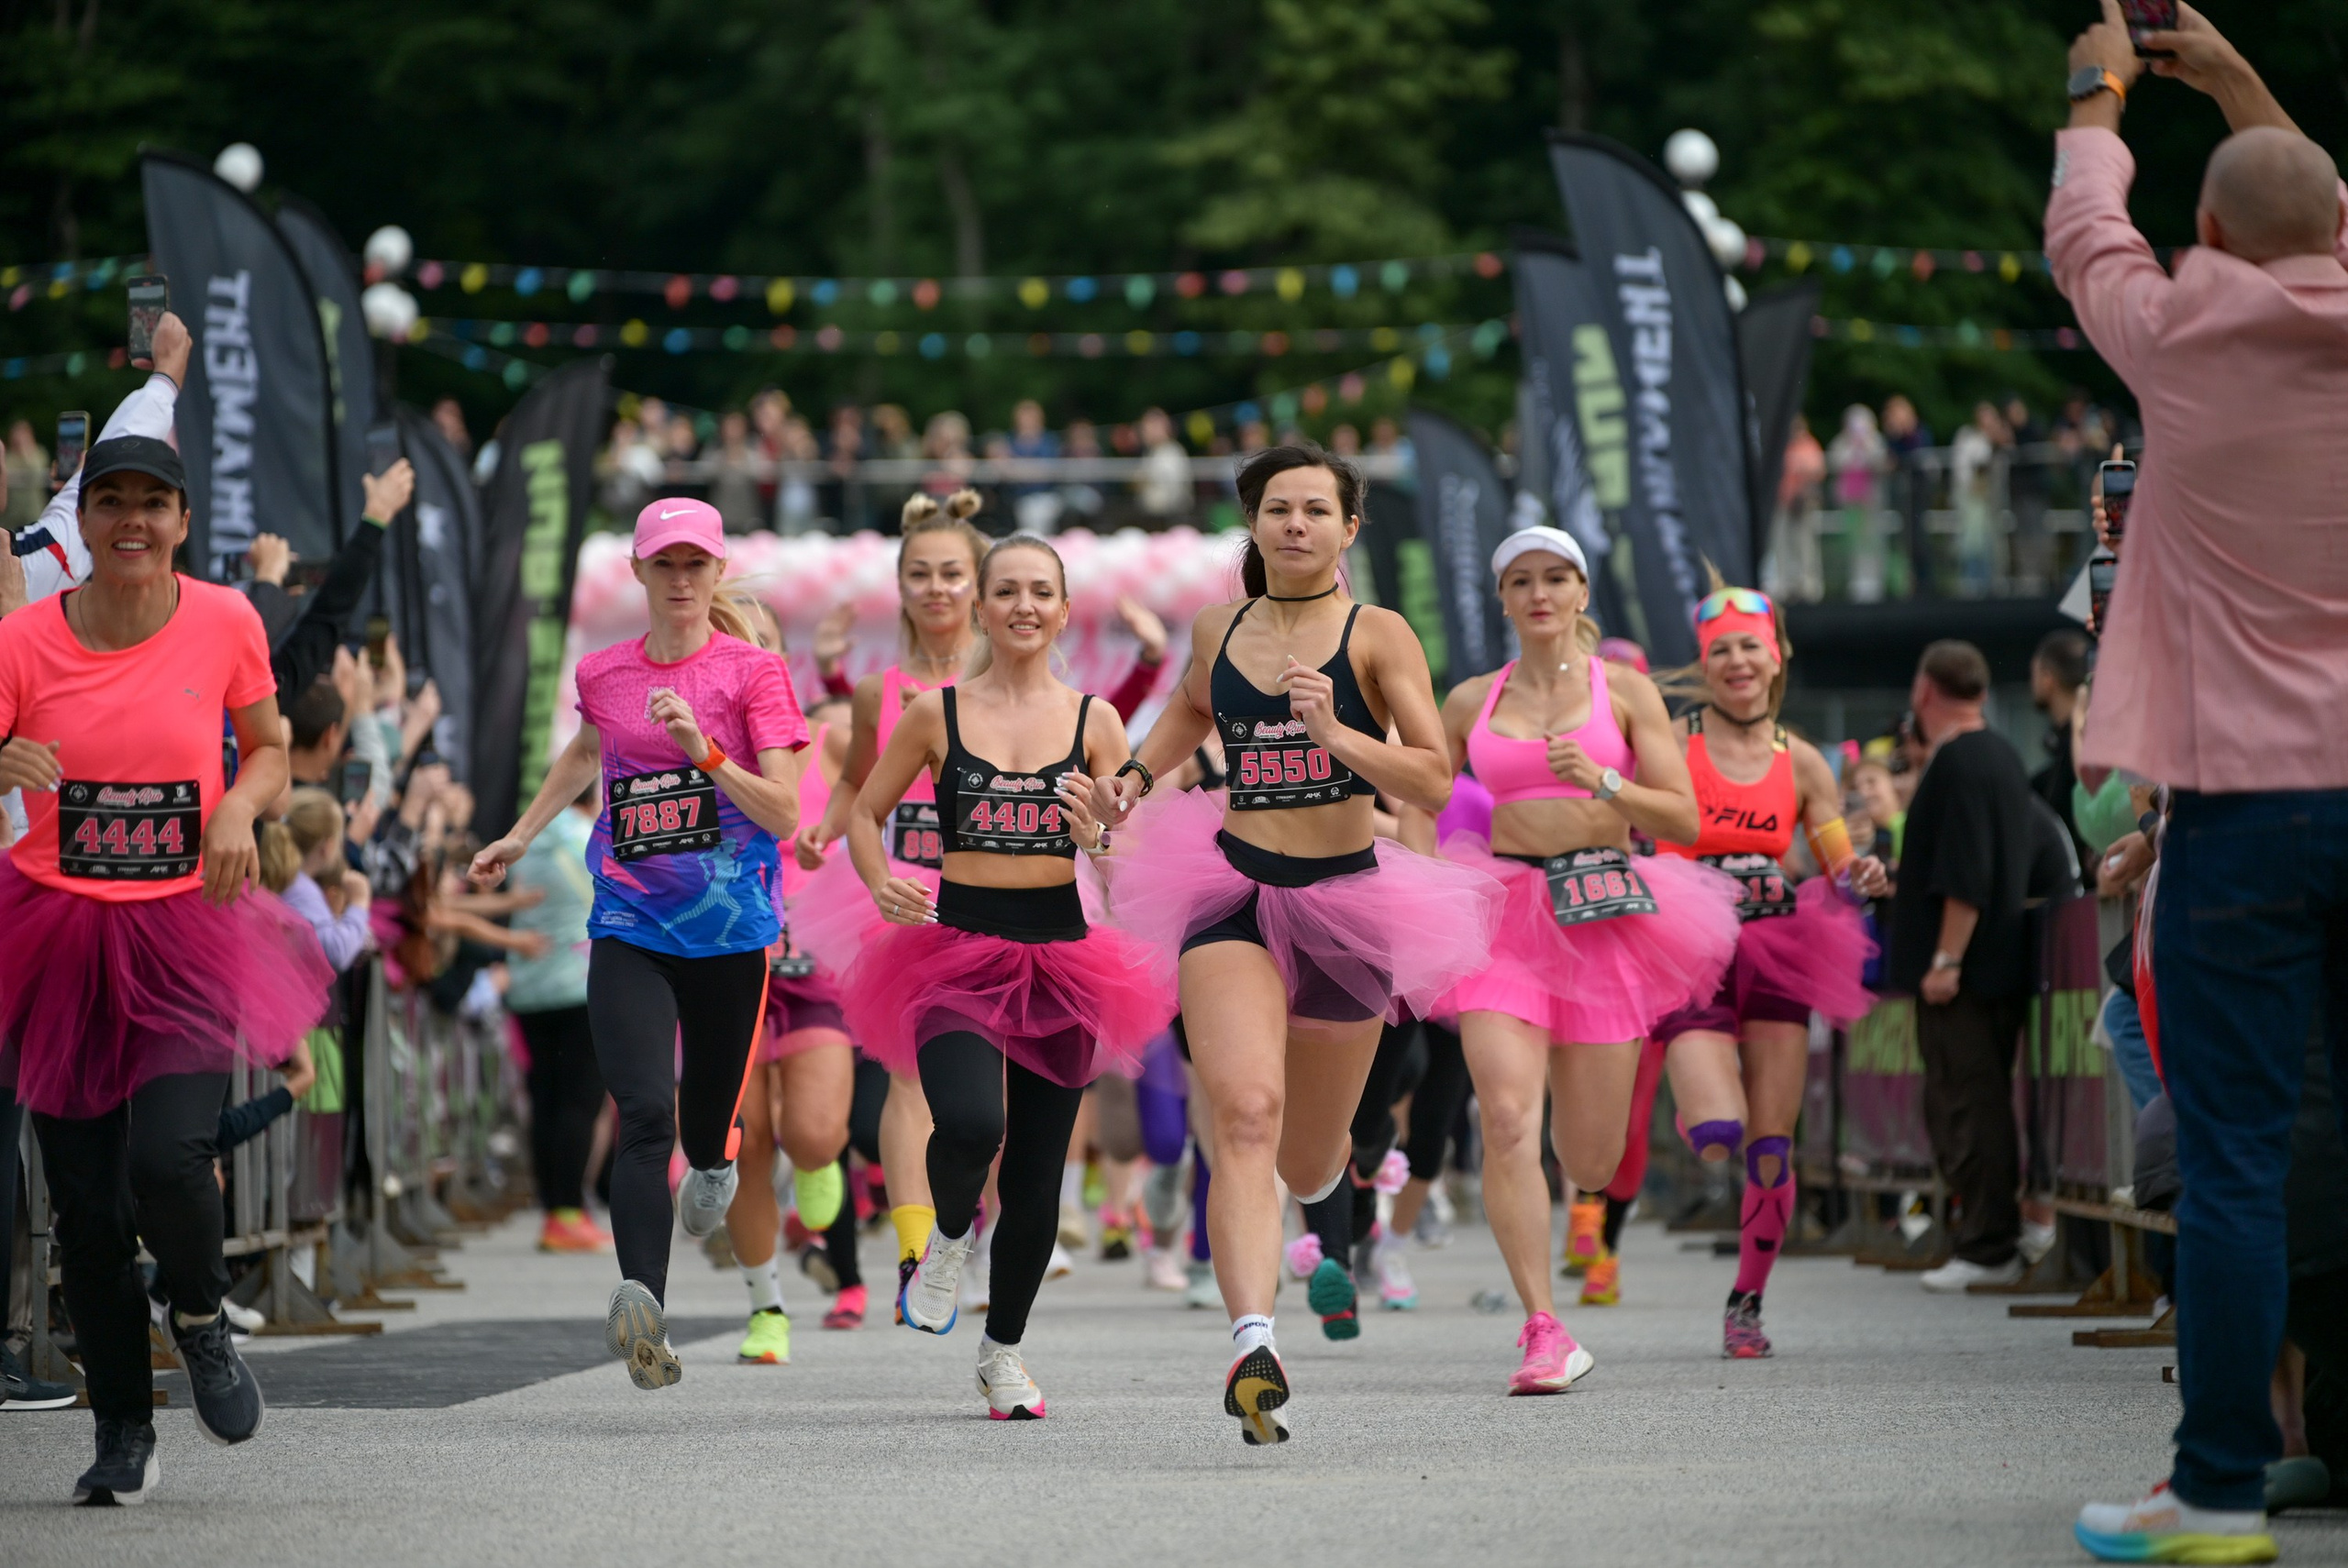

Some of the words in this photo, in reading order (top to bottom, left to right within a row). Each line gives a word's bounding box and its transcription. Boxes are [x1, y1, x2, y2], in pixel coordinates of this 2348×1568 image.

[1254, 721, 1285, 739] Beauty
[1284, 720, 1306, 737] Run
[1241, 747, 1332, 785] 5550
[96, 786, 137, 807] Beauty
[136, 787, 164, 805] Run
[629, 776, 659, 794] Beauty
[659, 773, 681, 790] Run
[990, 775, 1024, 793] Beauty
[1023, 777, 1047, 791] Run
[619, 796, 701, 838] 7887
[970, 801, 1061, 833] 4404
[1715, 807, 1778, 831] FILA
[74, 817, 184, 856] 4444
[903, 830, 944, 860] 89
[1564, 869, 1644, 907] 1661
[1735, 876, 1785, 903] 13
